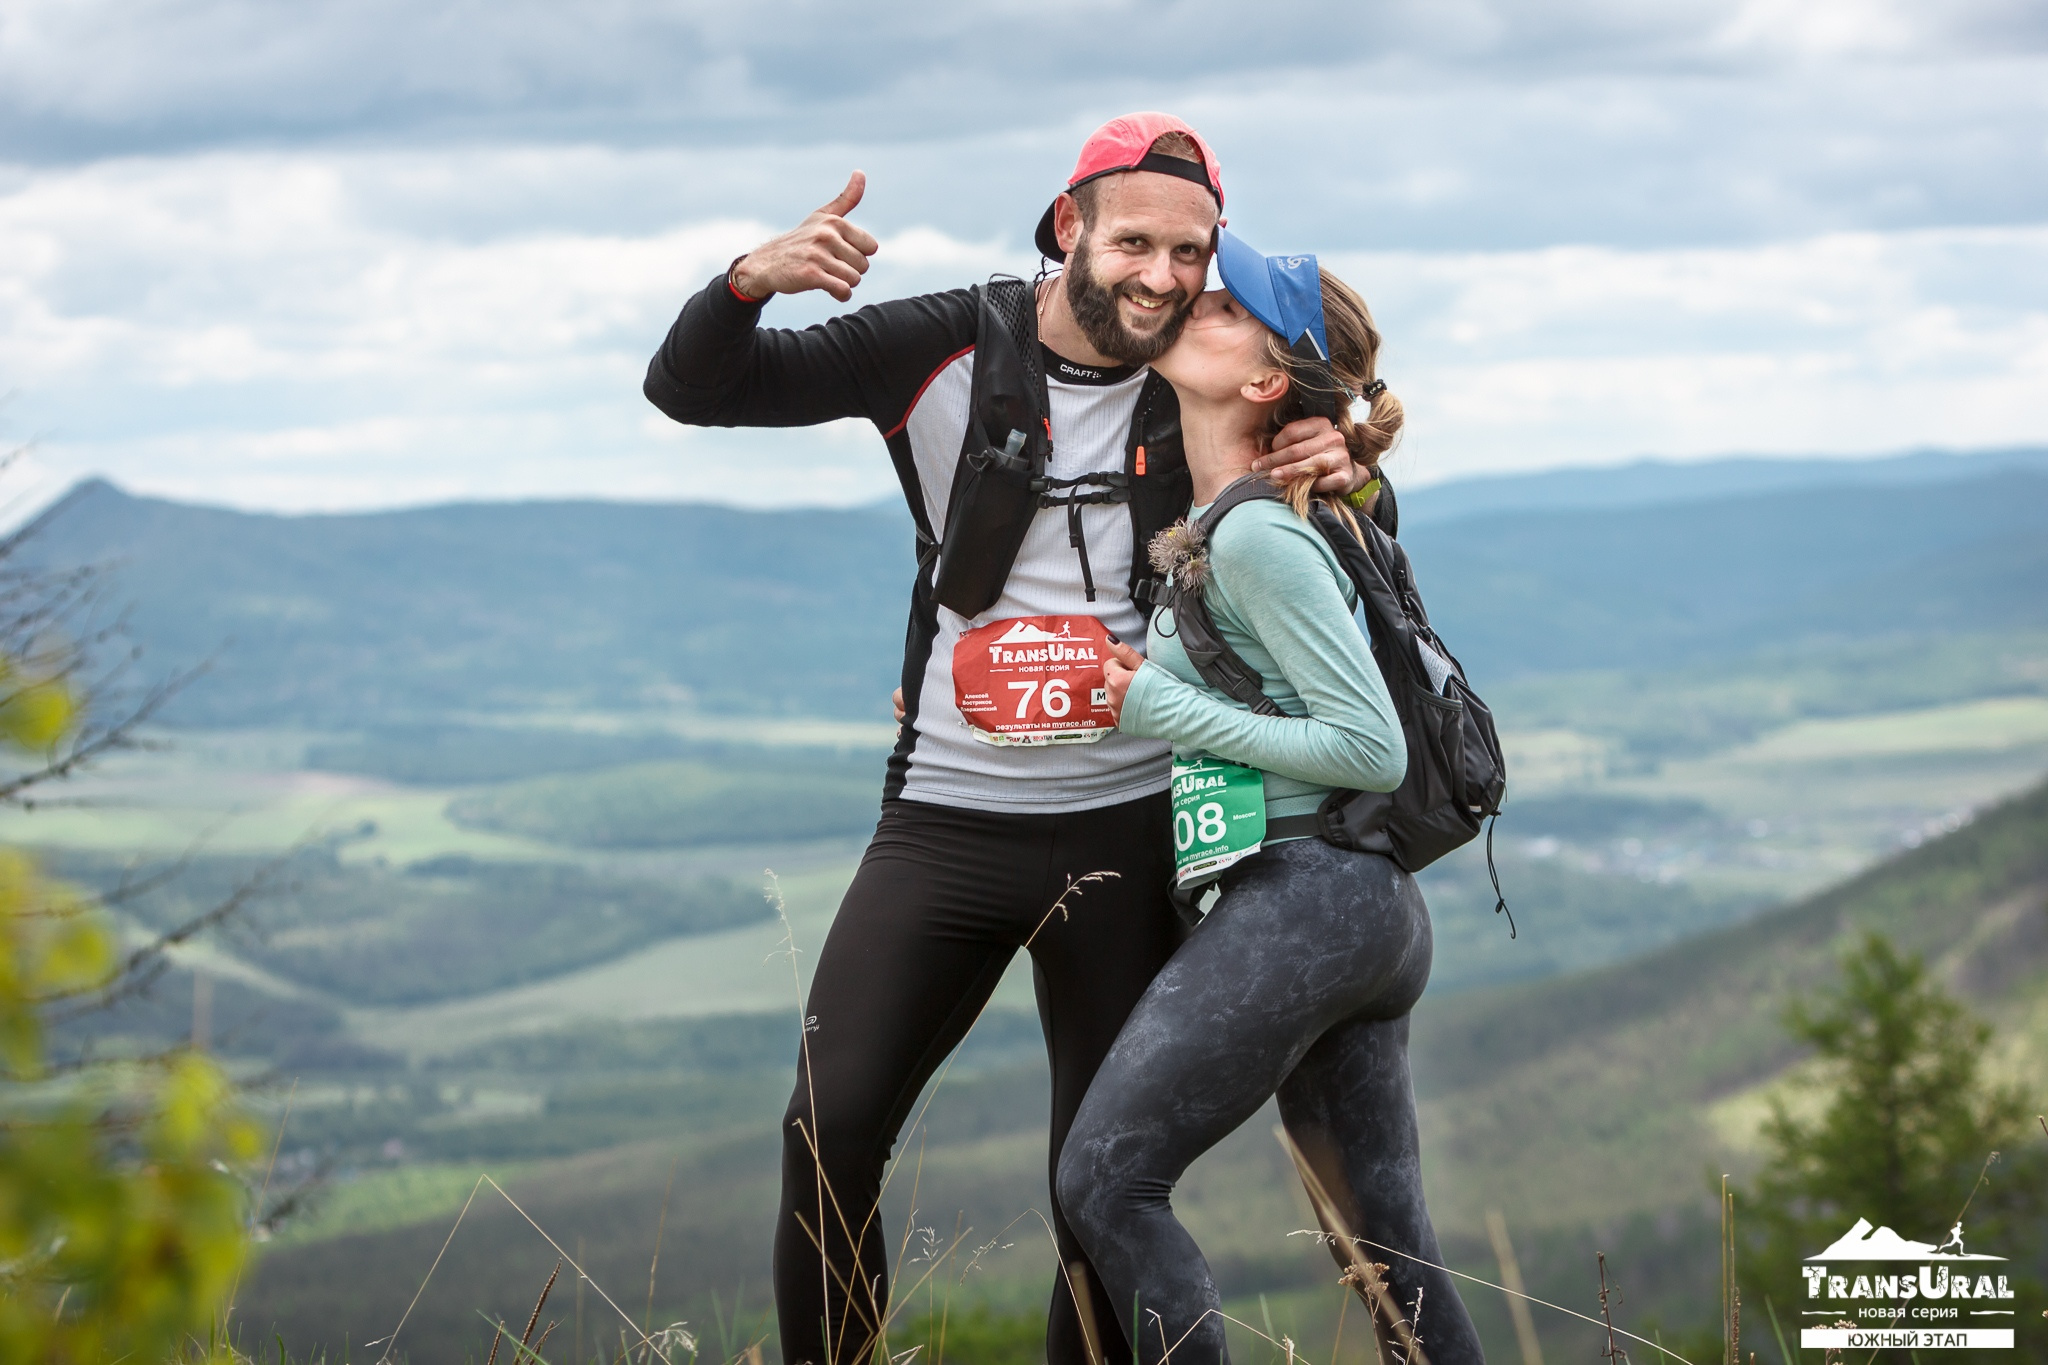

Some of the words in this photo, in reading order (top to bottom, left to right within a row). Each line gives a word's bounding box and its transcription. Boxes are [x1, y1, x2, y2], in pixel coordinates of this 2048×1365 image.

[1060, 363, 1093, 378] CRAFT
[1045, 664, 1070, 673] серия
[1007, 678, 1072, 719] 76
[995, 723, 1041, 732] результаты
[1051, 719, 1097, 729] myrace.info
[1180, 794, 1201, 806] серия
[1232, 811, 1257, 821] Moscow
[1189, 845, 1229, 860] myrace.info
